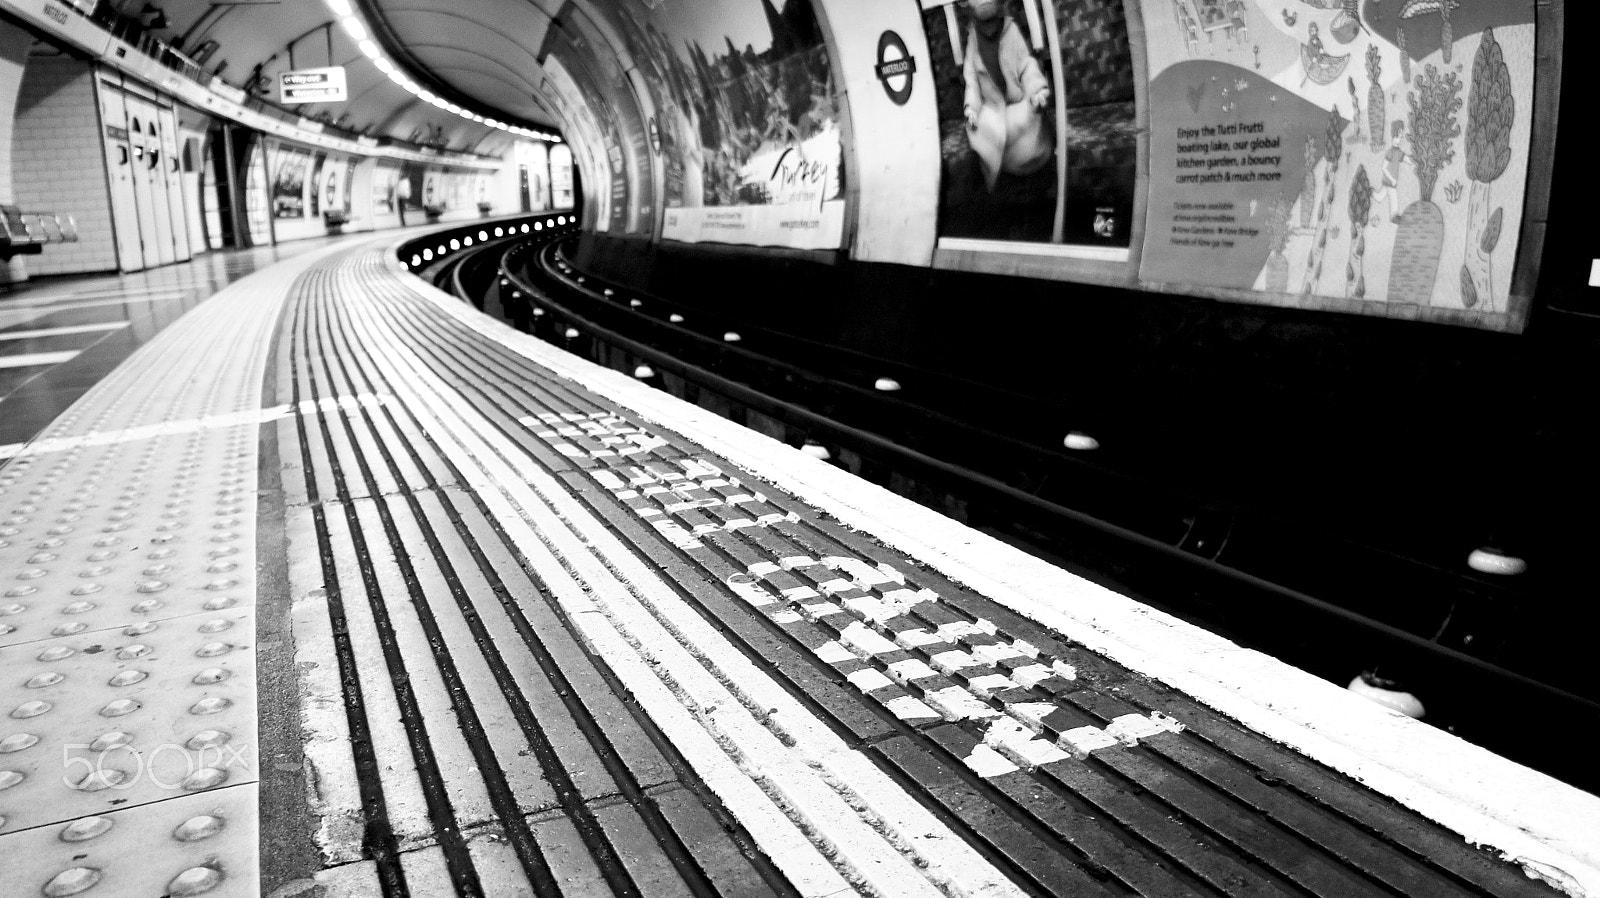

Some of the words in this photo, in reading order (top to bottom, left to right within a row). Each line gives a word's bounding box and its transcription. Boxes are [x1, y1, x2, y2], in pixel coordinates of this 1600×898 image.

[43, 3, 68, 25] WATERLOO
[882, 61, 908, 74] WATERLOO
[291, 76, 307, 84] Way
[307, 75, 321, 83] out
[1177, 127, 1199, 139] Enjoy
[1201, 126, 1215, 136] the
[1217, 124, 1236, 134] Tutti
[1239, 122, 1264, 133] Frutti
[1177, 142, 1208, 154] boating
[1210, 141, 1230, 152] lake,
[1233, 142, 1248, 150] our
[1250, 136, 1280, 151] global
[1176, 157, 1205, 168] kitchen
[1207, 156, 1239, 169] garden,
[1241, 157, 1246, 165] a
[1248, 155, 1281, 167] bouncy
[1176, 173, 1198, 183] carrot
[1200, 172, 1223, 184] patch
[1224, 172, 1231, 182] &
[1231, 171, 1256, 182] much
[1257, 172, 1281, 181] more
[518, 411, 668, 459] GAP
[590, 458, 801, 550] THE
[727, 555, 1184, 777] MIND
